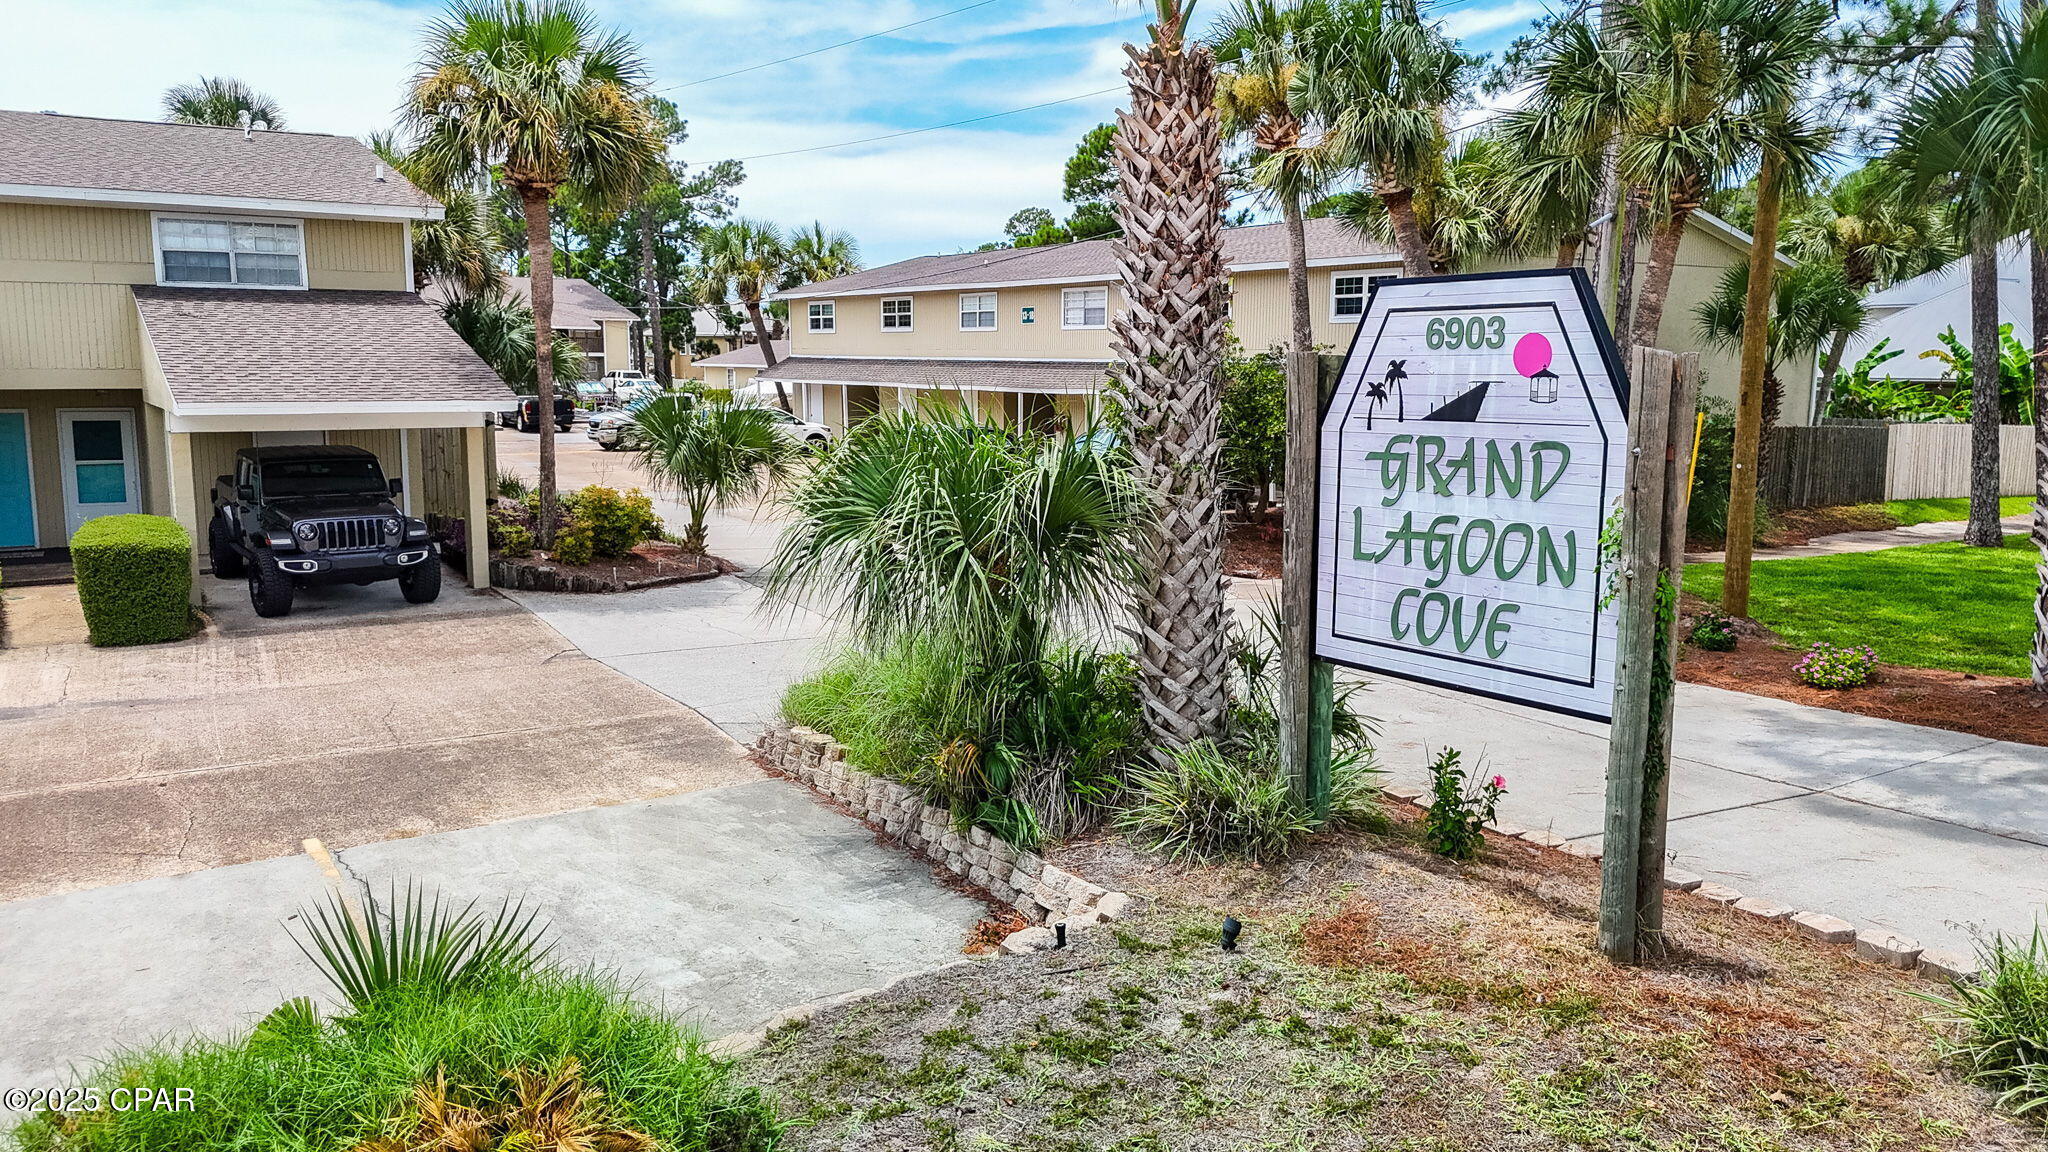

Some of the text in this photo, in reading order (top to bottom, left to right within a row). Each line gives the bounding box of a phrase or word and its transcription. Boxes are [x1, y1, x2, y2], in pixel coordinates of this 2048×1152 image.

[1426, 316, 1506, 350] 6903
[1365, 434, 1571, 506] GRAND
[1352, 507, 1576, 588] LAGOON
[1390, 588, 1520, 659] COVE
